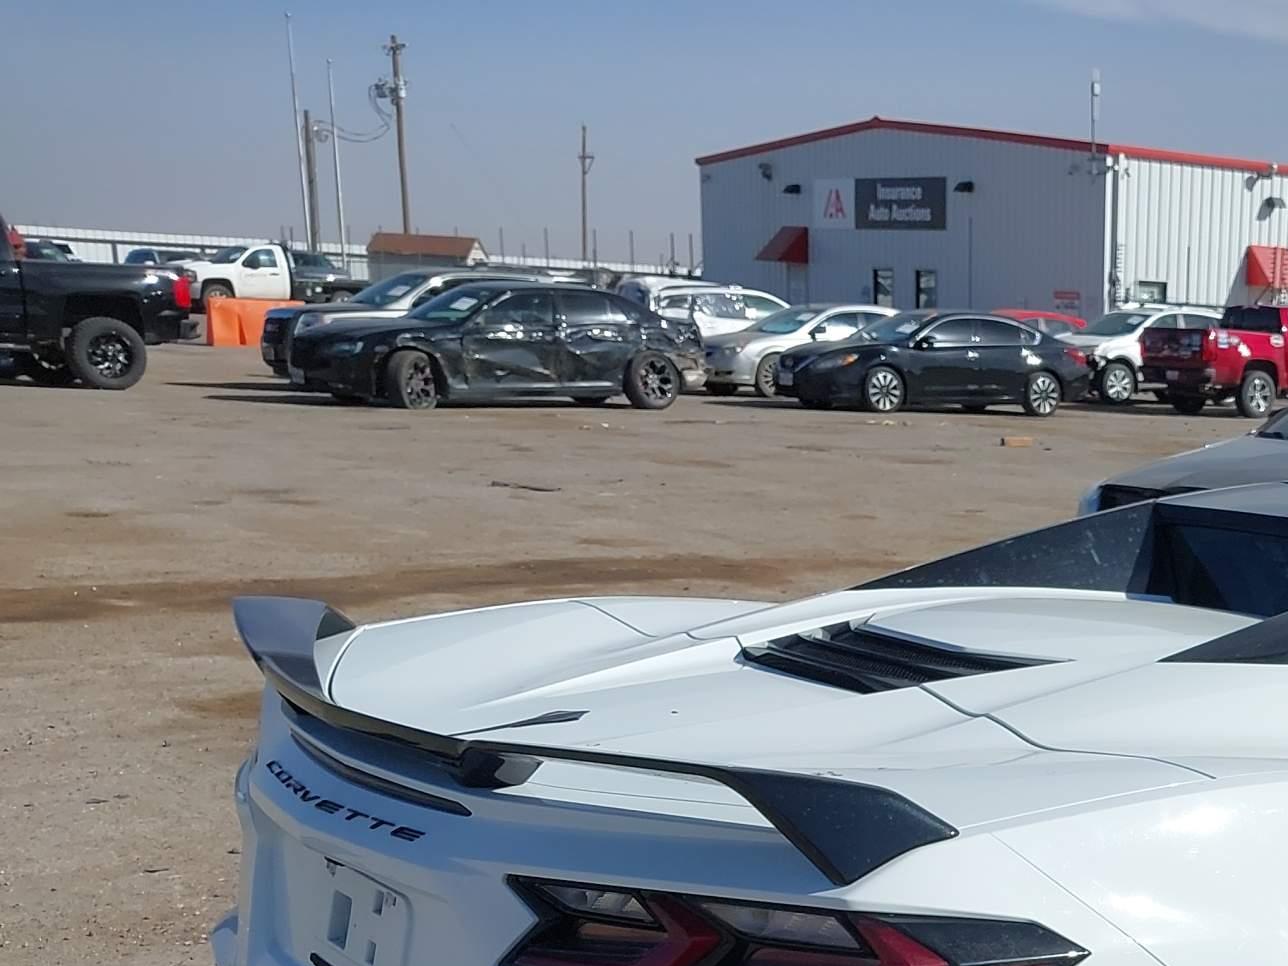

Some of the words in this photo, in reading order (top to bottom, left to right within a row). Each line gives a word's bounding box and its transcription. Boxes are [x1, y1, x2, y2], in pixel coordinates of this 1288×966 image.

[877, 183, 922, 200] Insurance
[868, 203, 890, 221] Auto
[891, 203, 932, 222] Auctions
[266, 760, 426, 842] CORVETTE
